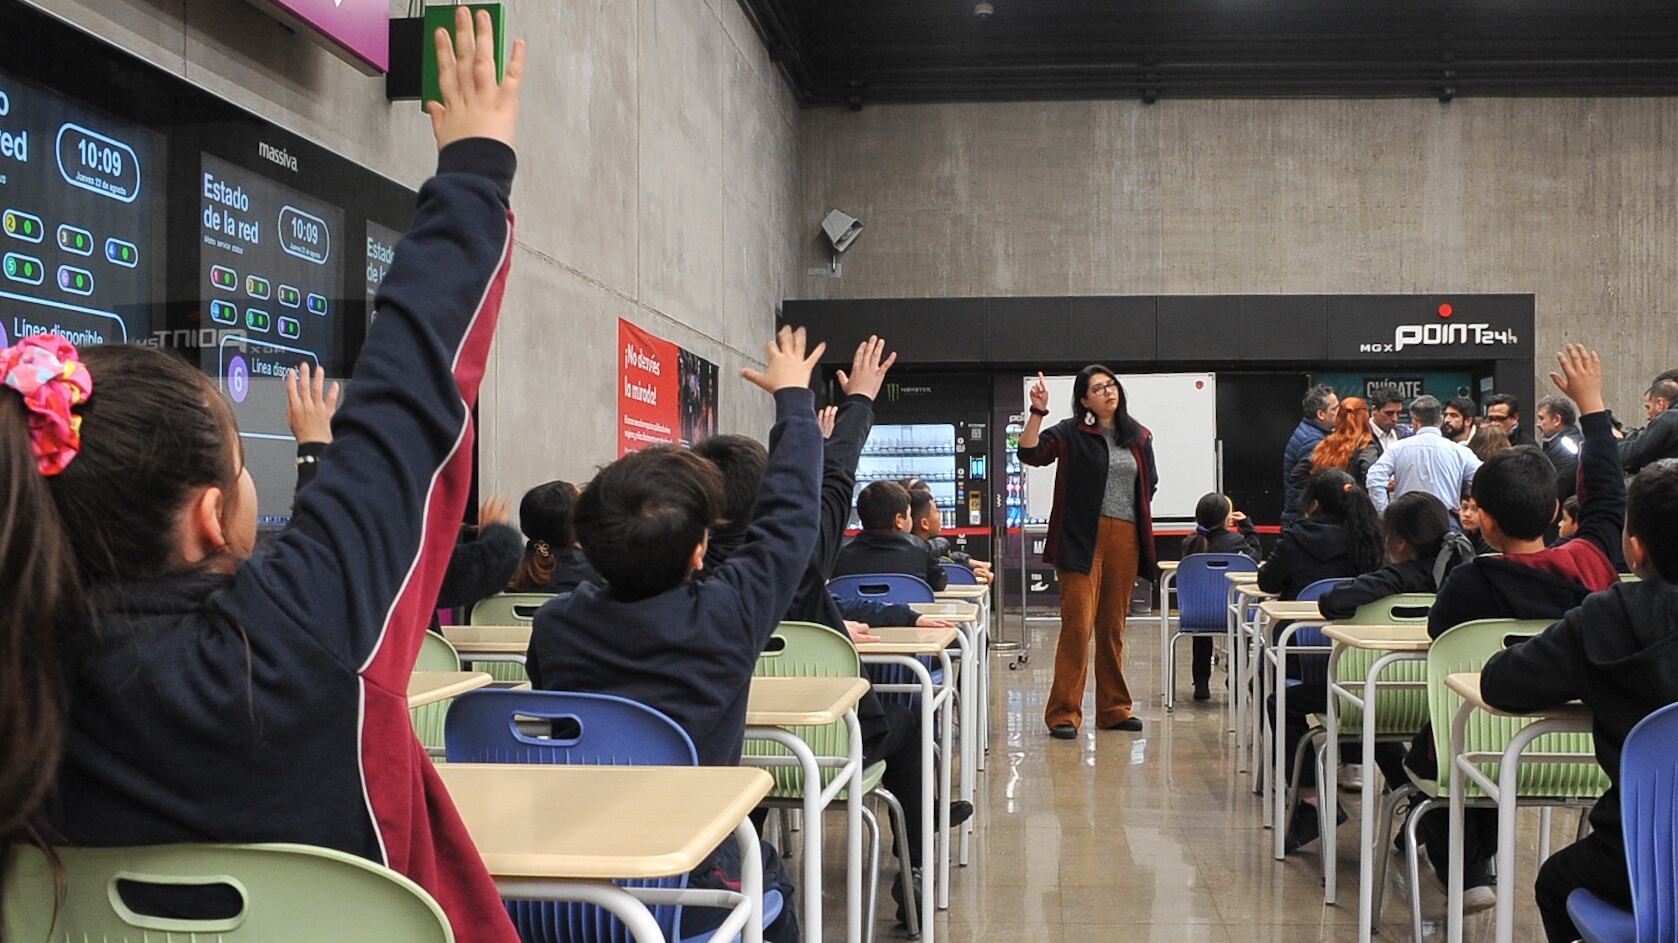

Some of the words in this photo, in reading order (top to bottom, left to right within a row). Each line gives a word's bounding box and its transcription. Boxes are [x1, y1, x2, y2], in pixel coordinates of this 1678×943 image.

[0, 130, 27, 161] ed
[78, 138, 121, 177] 10:09
[258, 141, 298, 172] massiva
[204, 172, 249, 212] Estado
[8, 217, 15, 228] 2
[60, 230, 67, 243] 3
[203, 205, 221, 231] de
[223, 210, 236, 236] la
[238, 221, 259, 244] red
[291, 217, 318, 245] 10:09
[366, 262, 379, 283] de
[637, 348, 661, 377] desvíes
[1360, 343, 1393, 353] MGX
[234, 366, 243, 393] 6
[624, 375, 632, 399] la
[632, 380, 657, 406] mirada!
